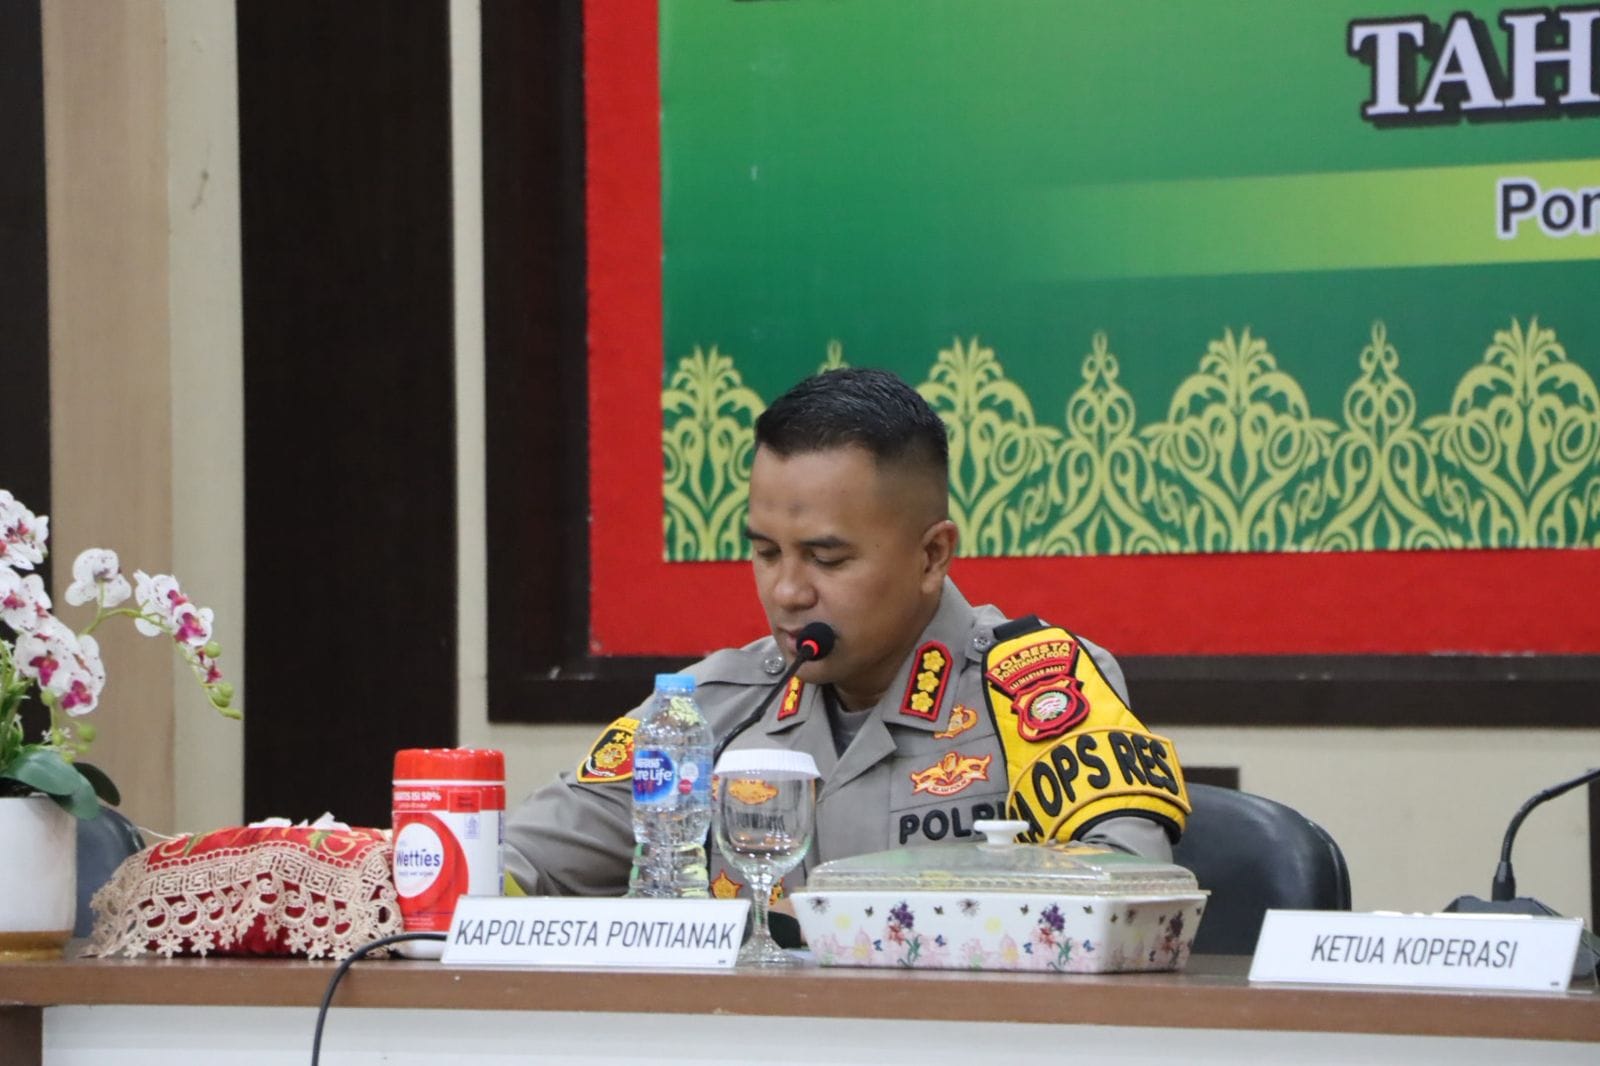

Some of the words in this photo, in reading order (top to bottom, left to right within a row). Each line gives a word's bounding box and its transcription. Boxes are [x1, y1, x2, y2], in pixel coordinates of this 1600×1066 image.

[991, 642, 1070, 680] POLRESTA
[1032, 734, 1110, 817] OPS
[1108, 731, 1179, 796] RES
[455, 919, 598, 947] KAPOLRESTA
[605, 920, 738, 949] PONTIANAK
[1311, 934, 1385, 964] KETUA
[1392, 937, 1519, 969] KOPERASI
